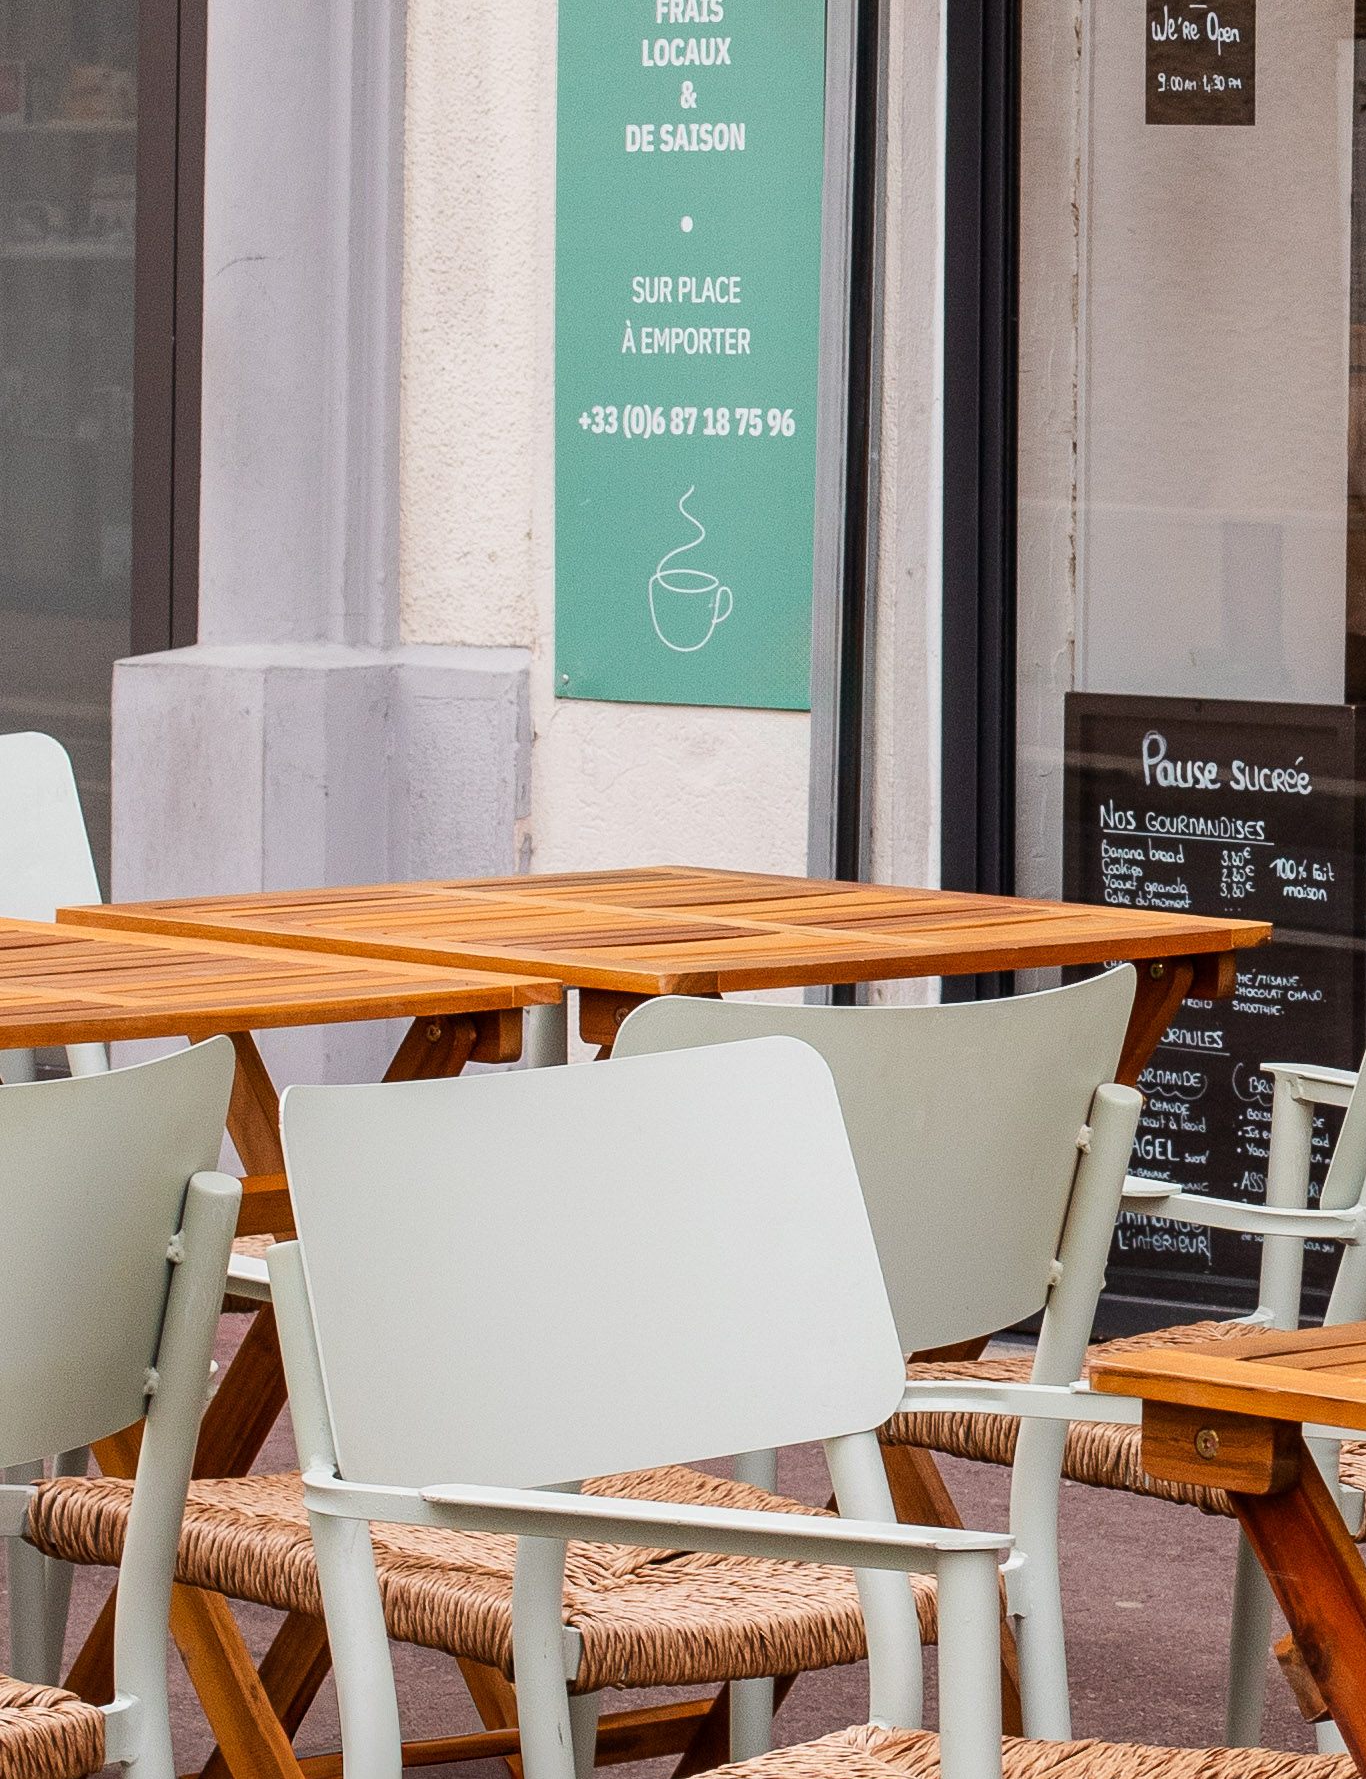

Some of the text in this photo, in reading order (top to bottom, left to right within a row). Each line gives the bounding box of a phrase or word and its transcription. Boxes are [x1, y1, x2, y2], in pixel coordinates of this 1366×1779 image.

[1206, 11, 1240, 56] Open
[641, 37, 732, 69] LOCAUX
[679, 80, 698, 110] &
[624, 121, 747, 154] DE SAISON
[631, 274, 742, 305] SUR PLACE
[621, 319, 752, 356] À EMPORTER
[578, 405, 796, 440] +33 (0)6 87 18 75 96
[1142, 729, 1221, 790] Pause
[1101, 839, 1185, 864] Banana bread
[1283, 884, 1328, 902] maison
